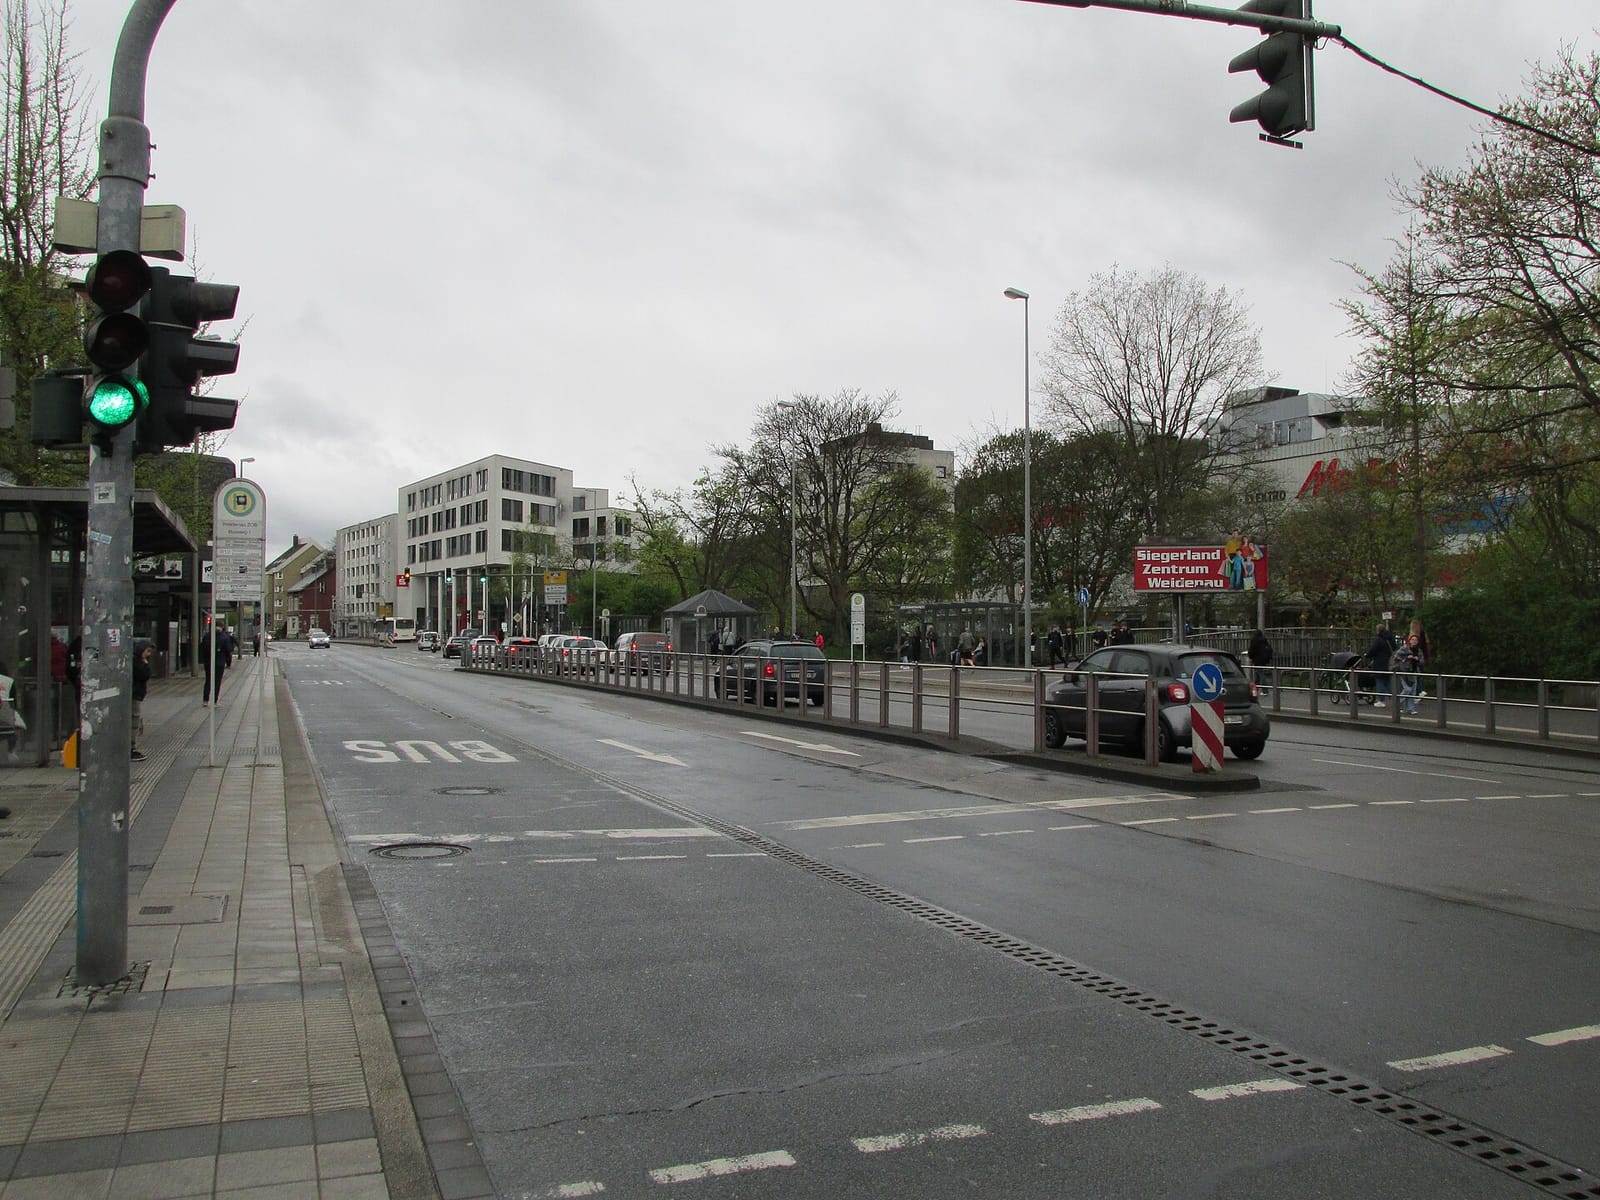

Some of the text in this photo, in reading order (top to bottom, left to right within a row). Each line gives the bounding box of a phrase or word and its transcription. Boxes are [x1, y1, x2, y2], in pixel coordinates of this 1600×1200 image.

[1137, 549, 1220, 563] Siegerland
[1142, 563, 1209, 575] Zentrum
[1147, 577, 1224, 588] Weidenau
[342, 740, 519, 763] BUS
